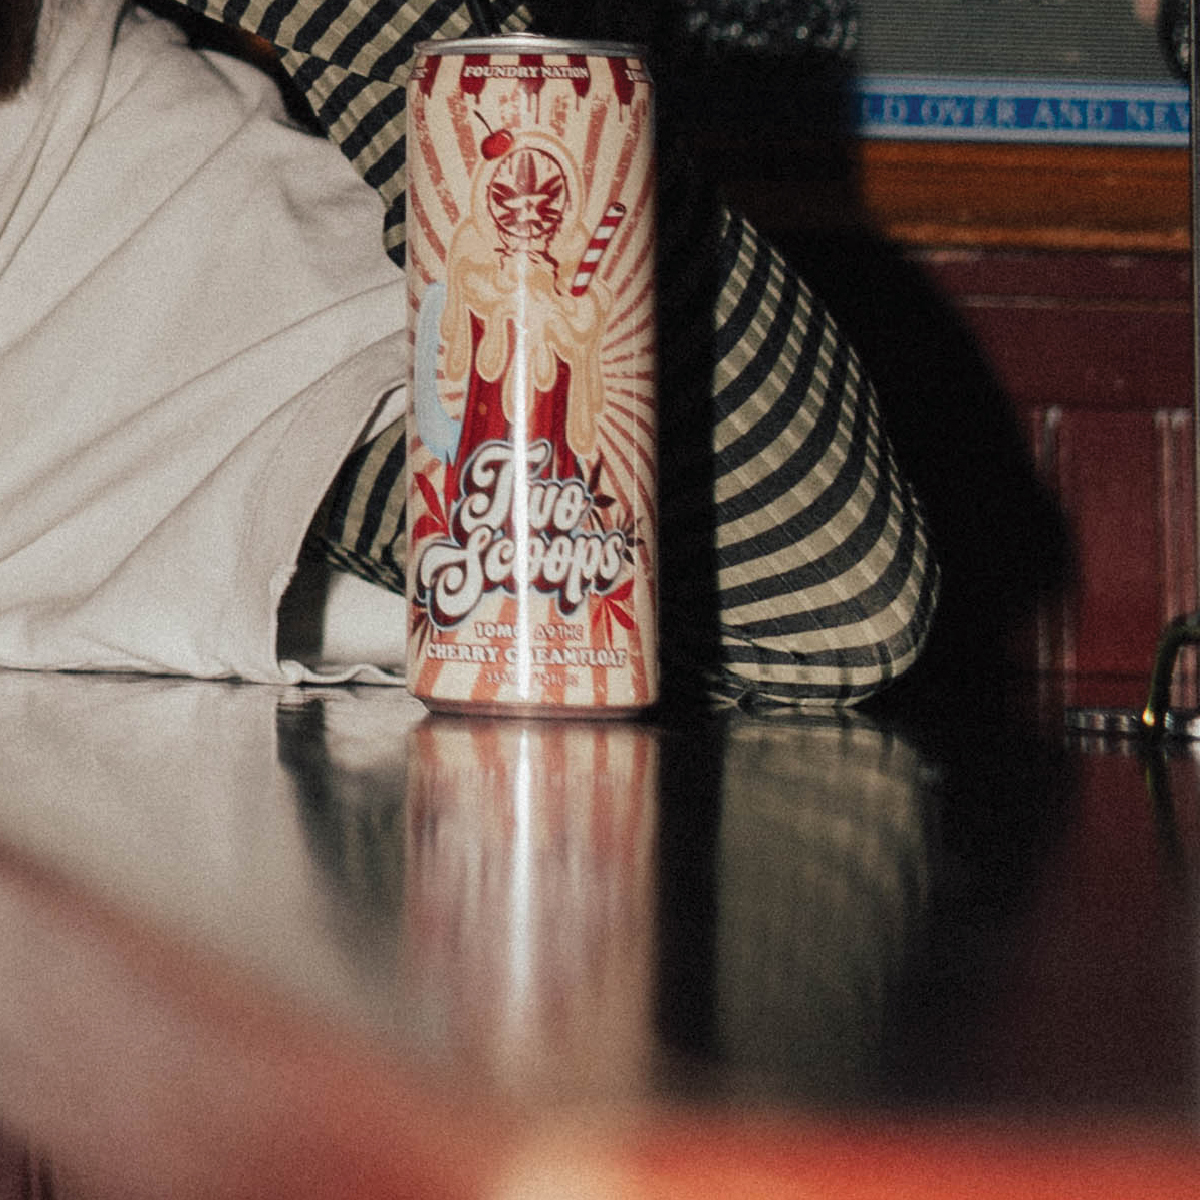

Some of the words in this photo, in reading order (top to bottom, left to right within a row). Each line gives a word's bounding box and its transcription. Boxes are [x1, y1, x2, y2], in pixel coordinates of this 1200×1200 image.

[463, 65, 539, 79] FOUNDRY
[540, 66, 589, 80] NATION
[921, 98, 1017, 129] OVER
[1032, 101, 1111, 131] AND
[418, 525, 624, 617] Scoops
[426, 643, 499, 663] CHERRY
[504, 646, 578, 666] CEAM
